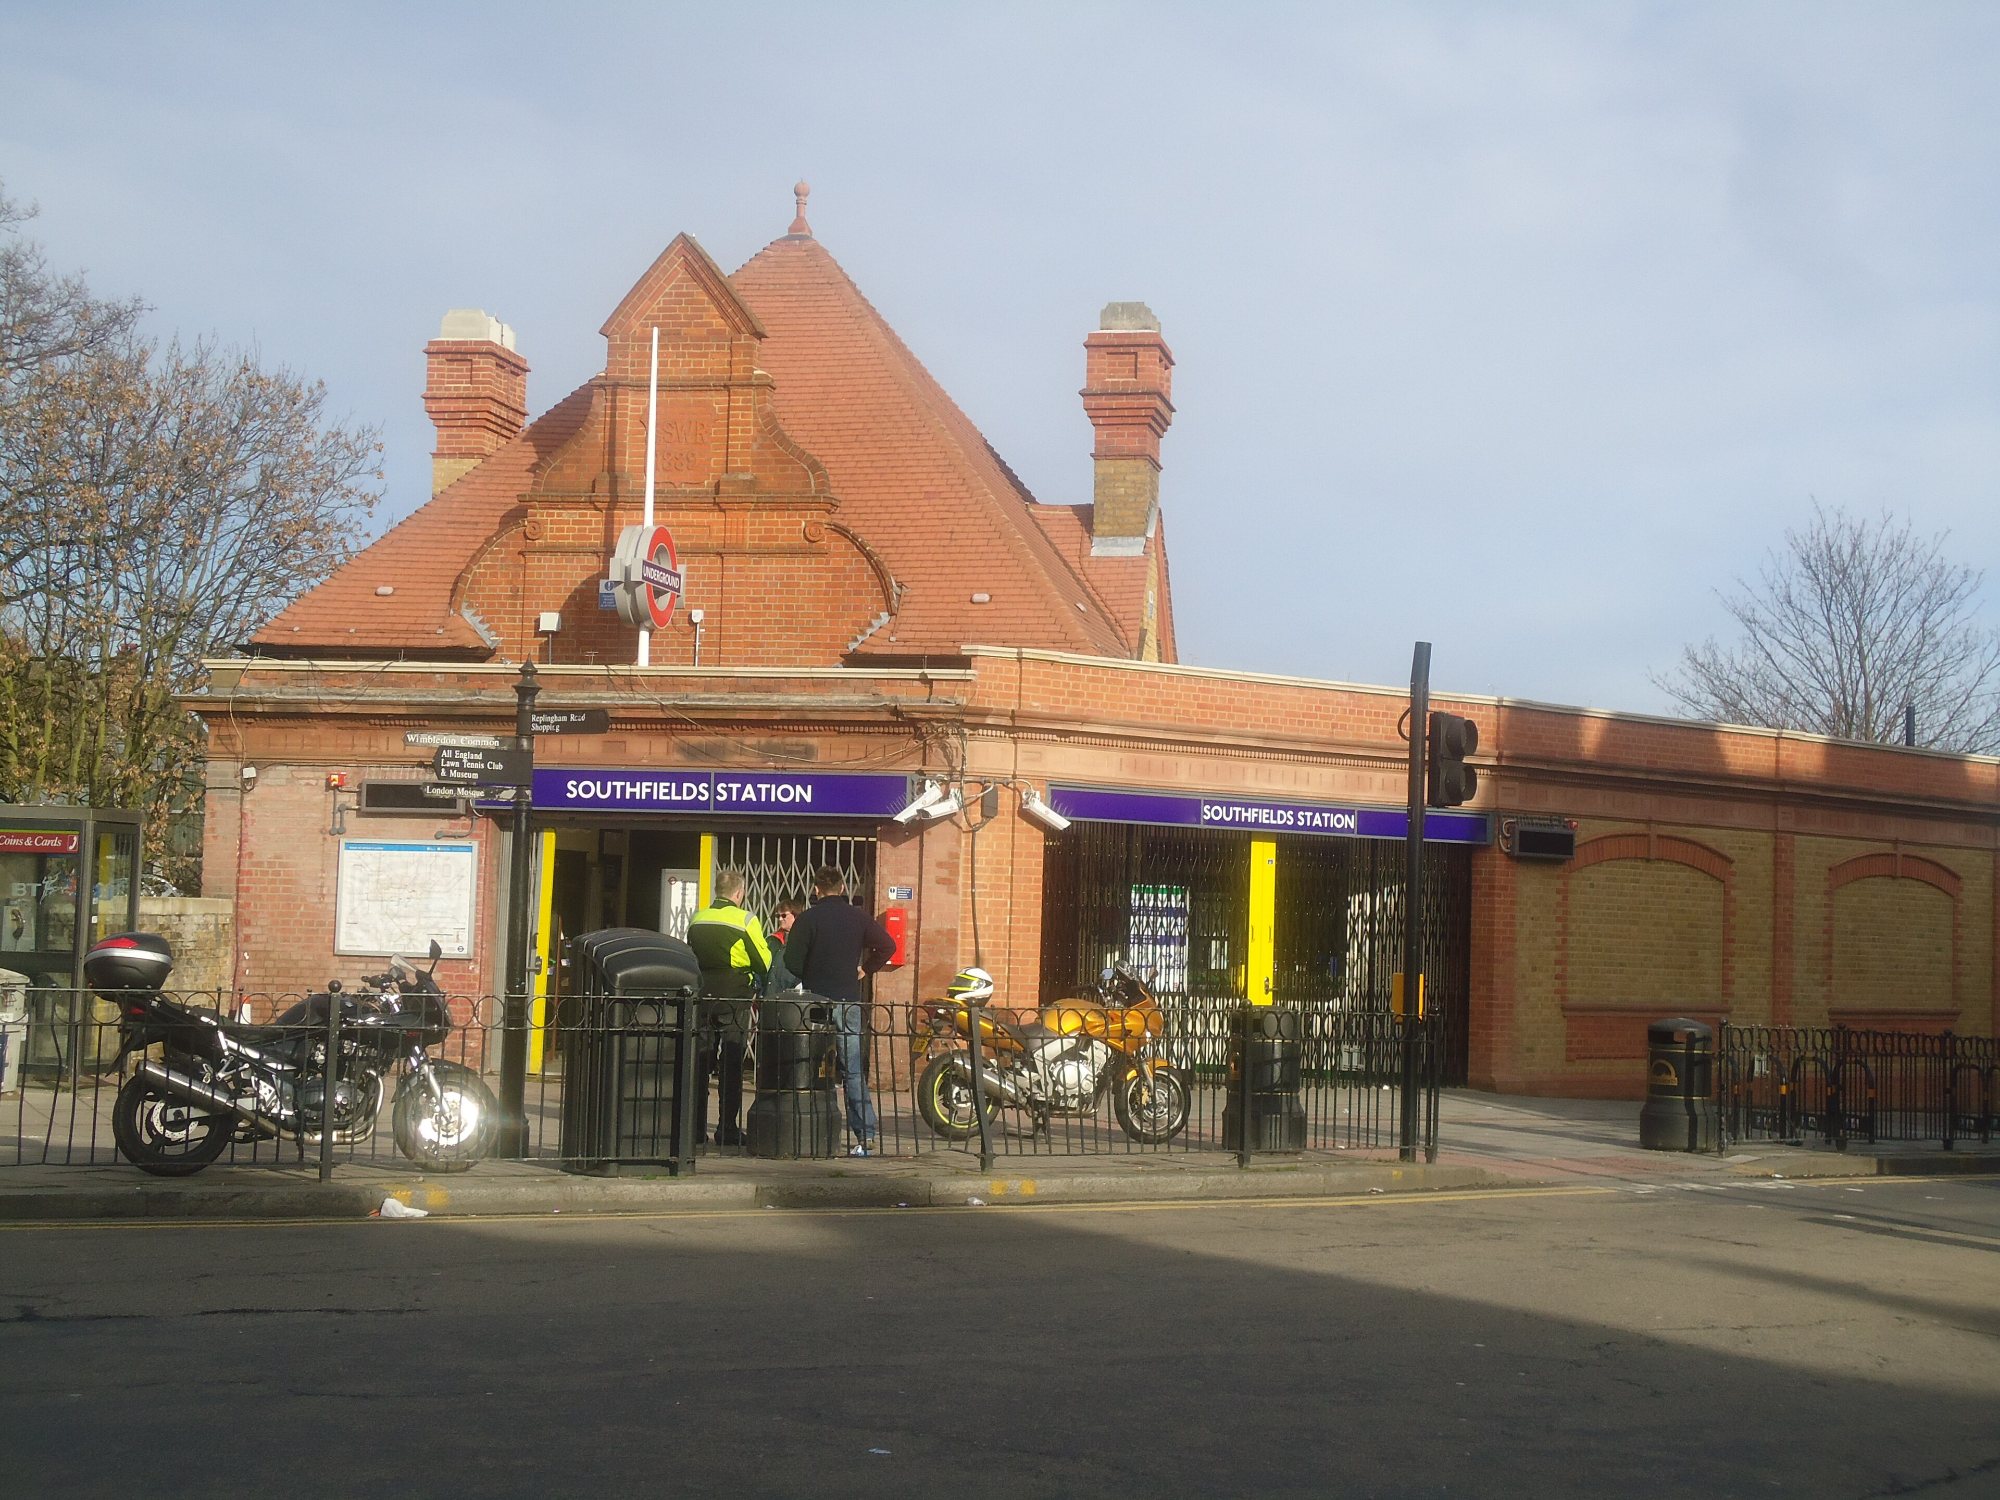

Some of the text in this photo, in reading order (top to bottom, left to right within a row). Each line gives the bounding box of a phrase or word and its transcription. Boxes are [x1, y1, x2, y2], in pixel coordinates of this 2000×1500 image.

[643, 564, 680, 589] UNDERGROUND
[531, 714, 568, 723] Replingham
[406, 733, 500, 747] Wimbledon Common
[441, 750, 483, 761] All England
[441, 759, 503, 770] Lawn Tennis Club
[440, 768, 479, 779] & Museum
[426, 785, 454, 796] London
[566, 780, 812, 803] SOUTHFIELDS STATION
[1203, 804, 1355, 830] SOUTHFIELDS STATION
[0, 835, 62, 847] Coins & Cards
[11, 882, 42, 897] BT
